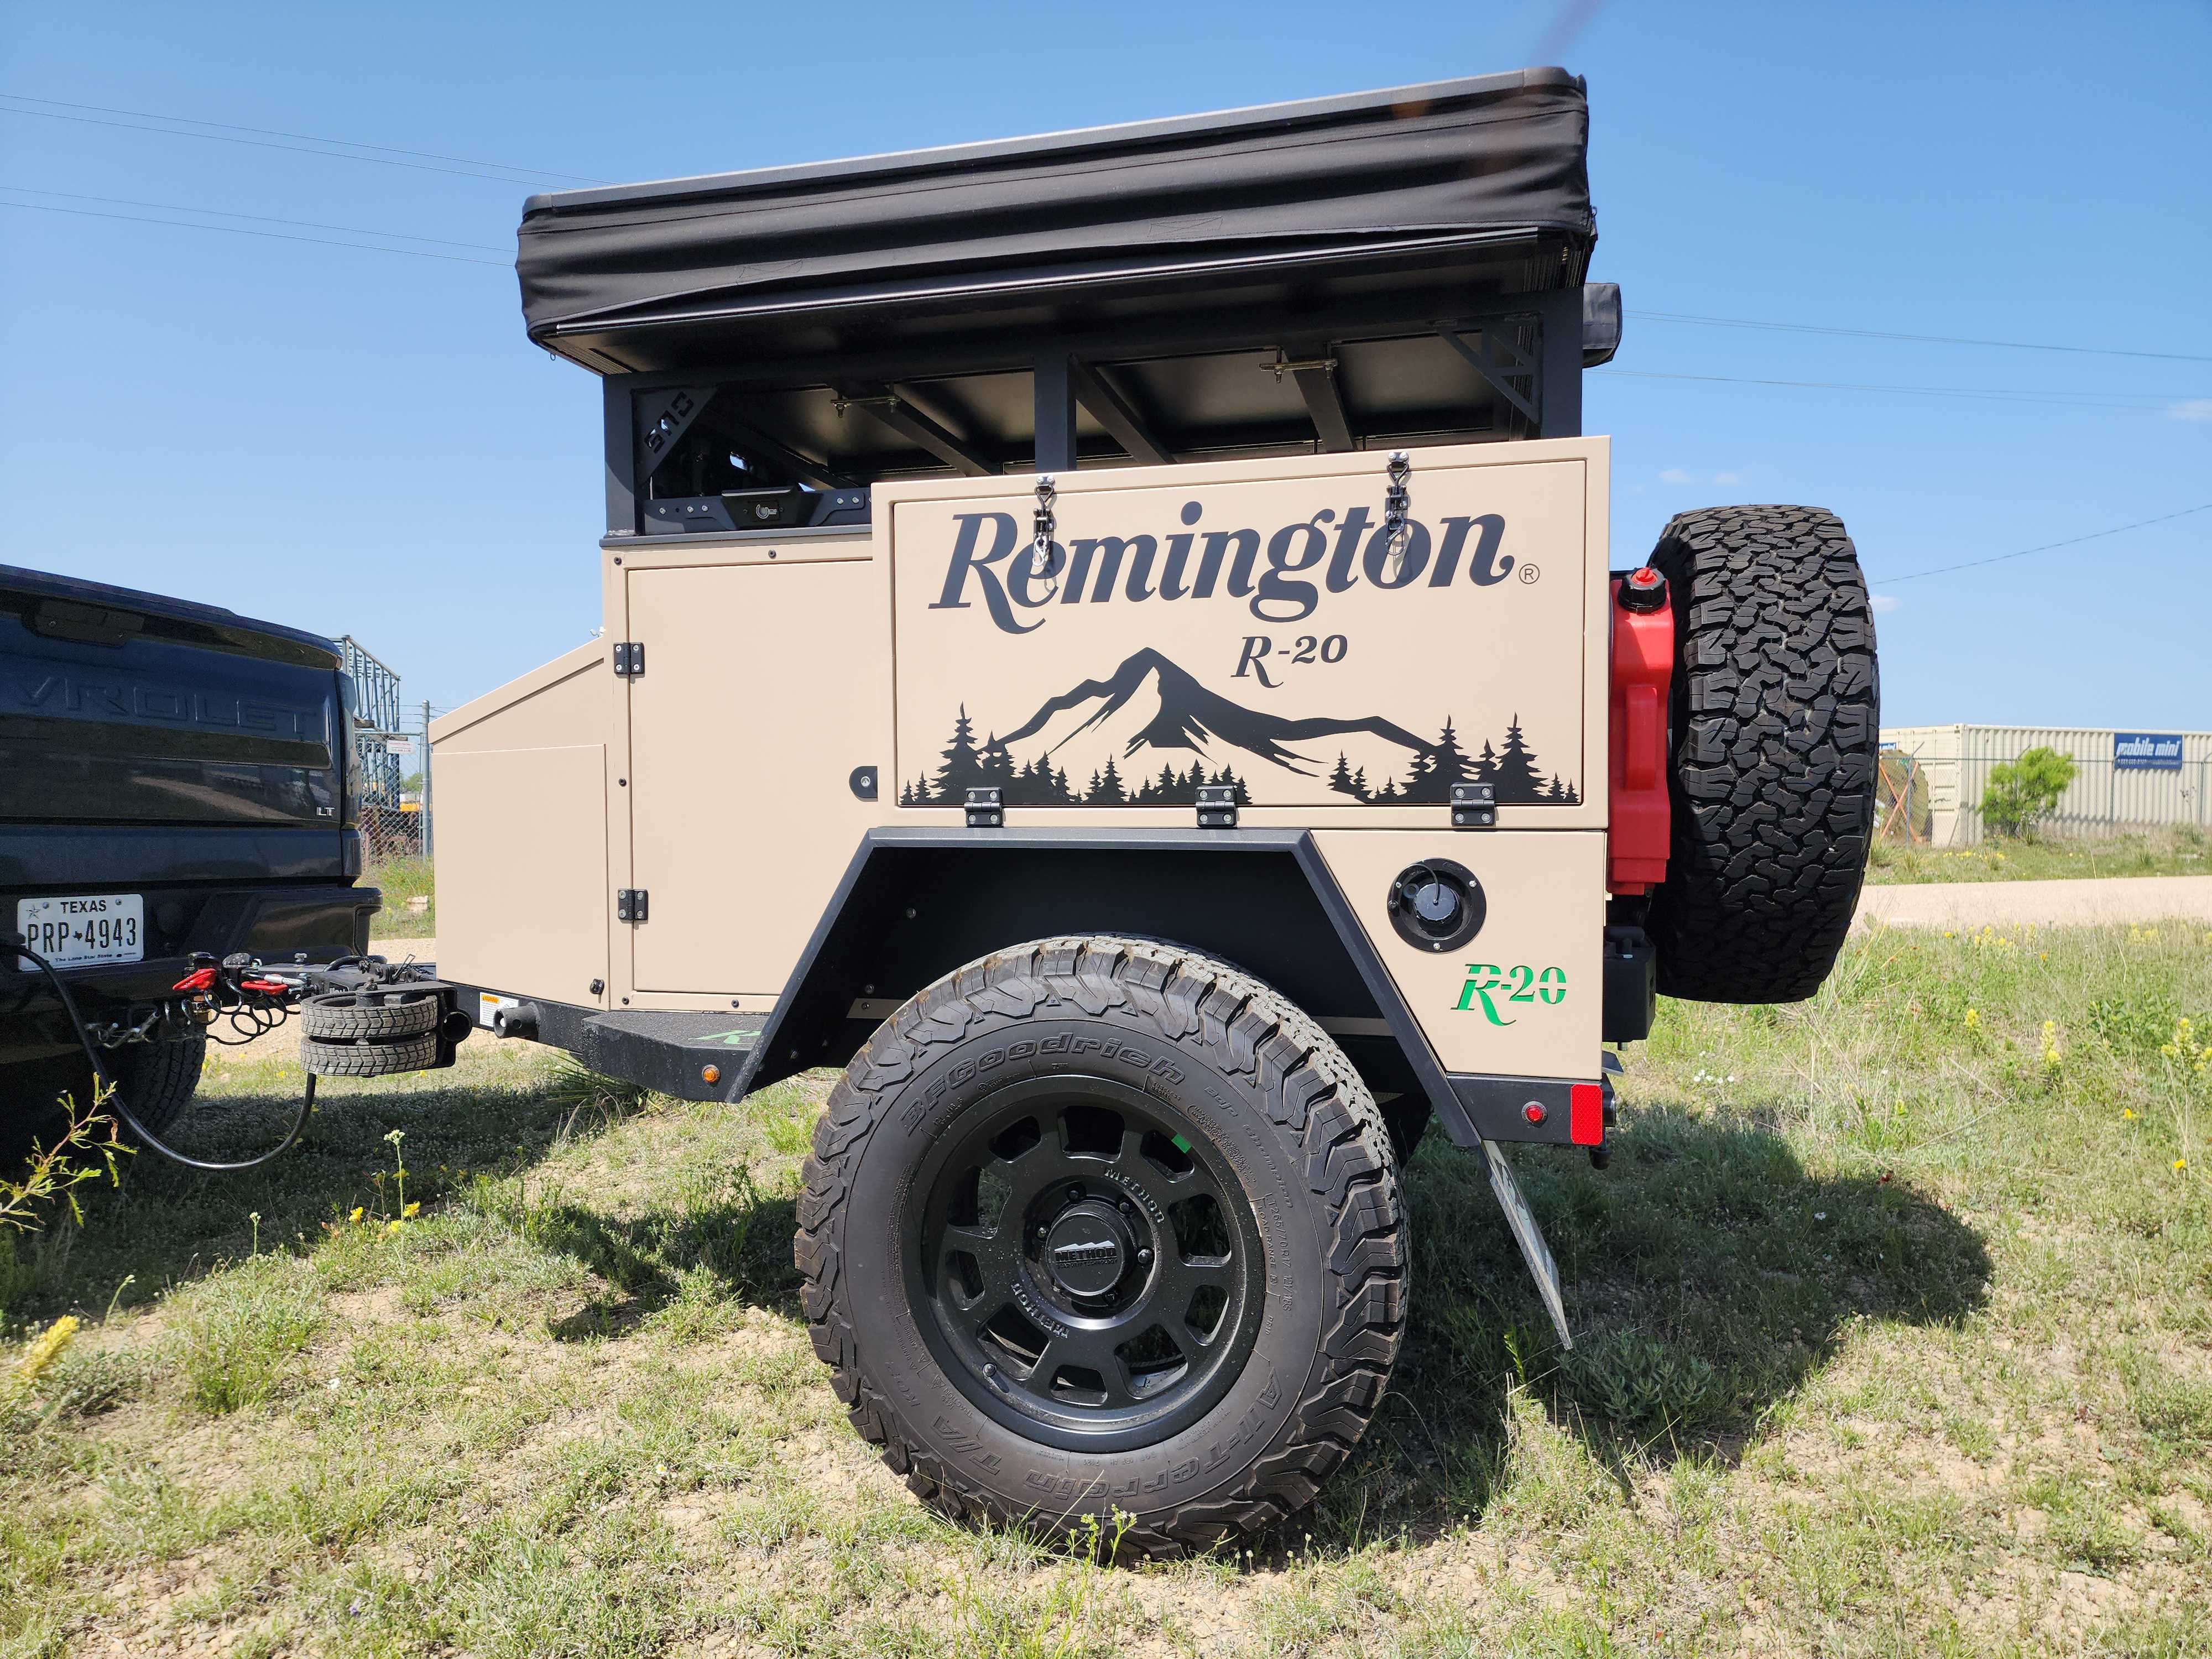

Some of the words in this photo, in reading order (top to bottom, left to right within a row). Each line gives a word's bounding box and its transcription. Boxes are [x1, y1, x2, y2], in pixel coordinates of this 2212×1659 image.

[928, 501, 1515, 634] Remington
[1232, 634, 1348, 688] R-20
[2116, 737, 2154, 756] mobile
[2155, 740, 2179, 756] mini
[316, 806, 335, 816] LT
[60, 900, 107, 914] TEXAS
[1451, 963, 1567, 1026] R-20
[898, 1032, 1186, 1136] BFGoodrich
[1204, 1086, 1238, 1117] Baja
[1244, 1124, 1293, 1208] Champion
[1104, 1168, 1165, 1223] METHOD
[1055, 1248, 1117, 1262] METHOD
[1258, 1206, 1270, 1233] LOAD
[1266, 1235, 1276, 1269] RANGE
[930, 1416, 1002, 1475] T/A
